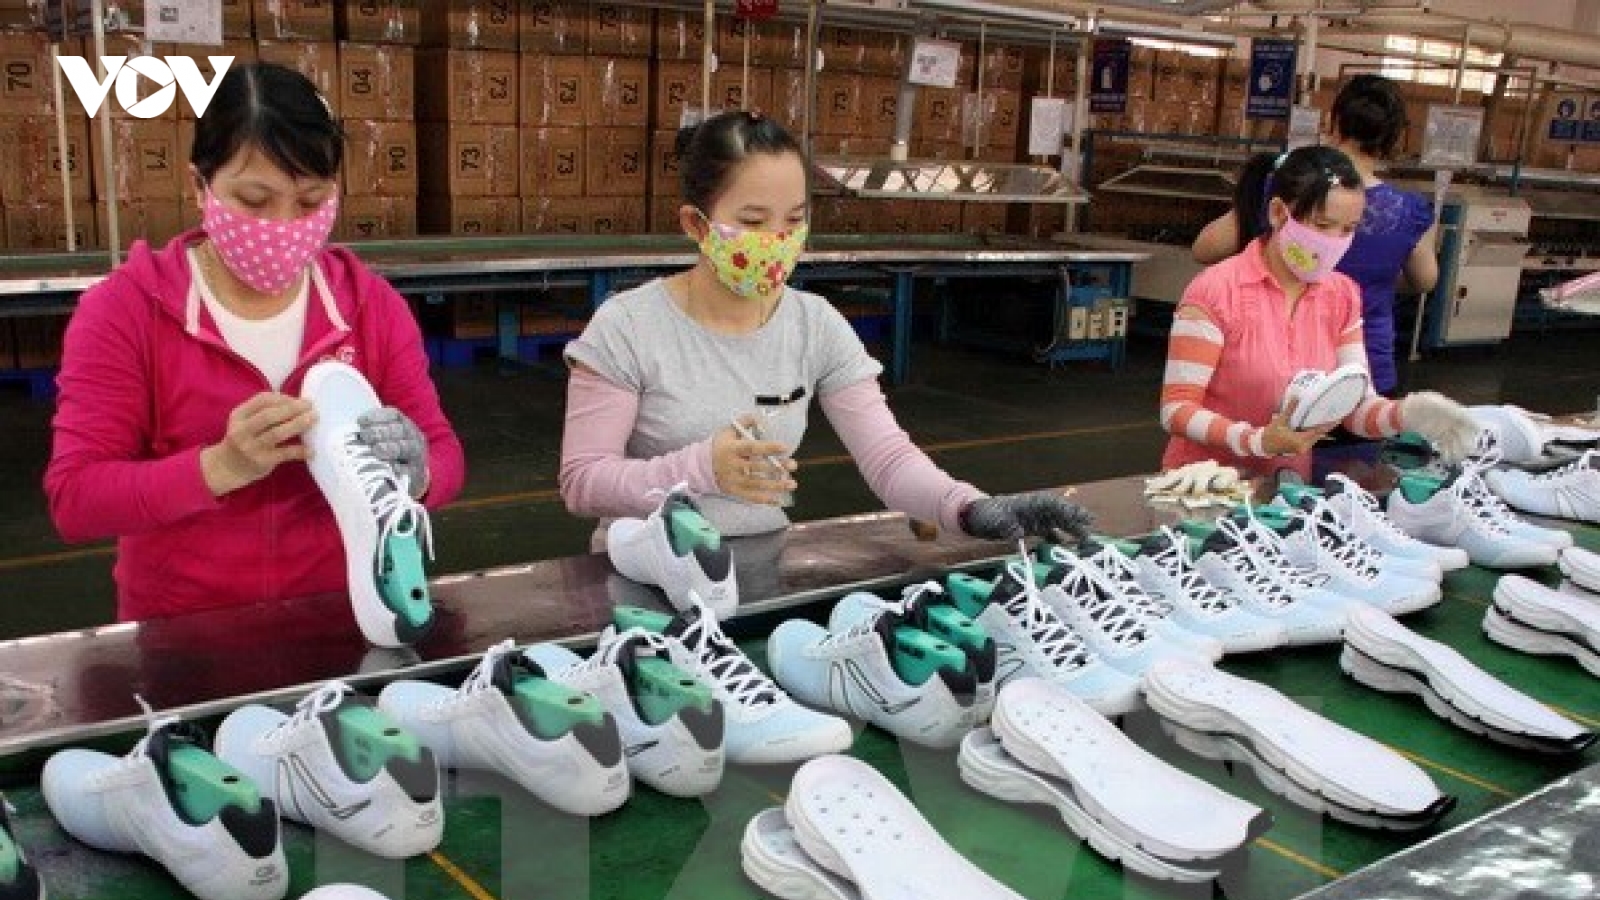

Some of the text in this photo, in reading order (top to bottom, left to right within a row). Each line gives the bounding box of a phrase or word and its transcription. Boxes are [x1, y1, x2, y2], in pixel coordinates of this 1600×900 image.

[6, 63, 32, 92] 70
[352, 68, 371, 94] 04
[487, 76, 508, 99] 73
[559, 79, 577, 104] 73
[620, 82, 637, 105] 73
[669, 82, 686, 104] 73
[143, 146, 167, 171] 71
[388, 146, 405, 171] 04
[460, 146, 479, 170] 73
[556, 152, 573, 176] 73
[620, 152, 637, 173] 73
